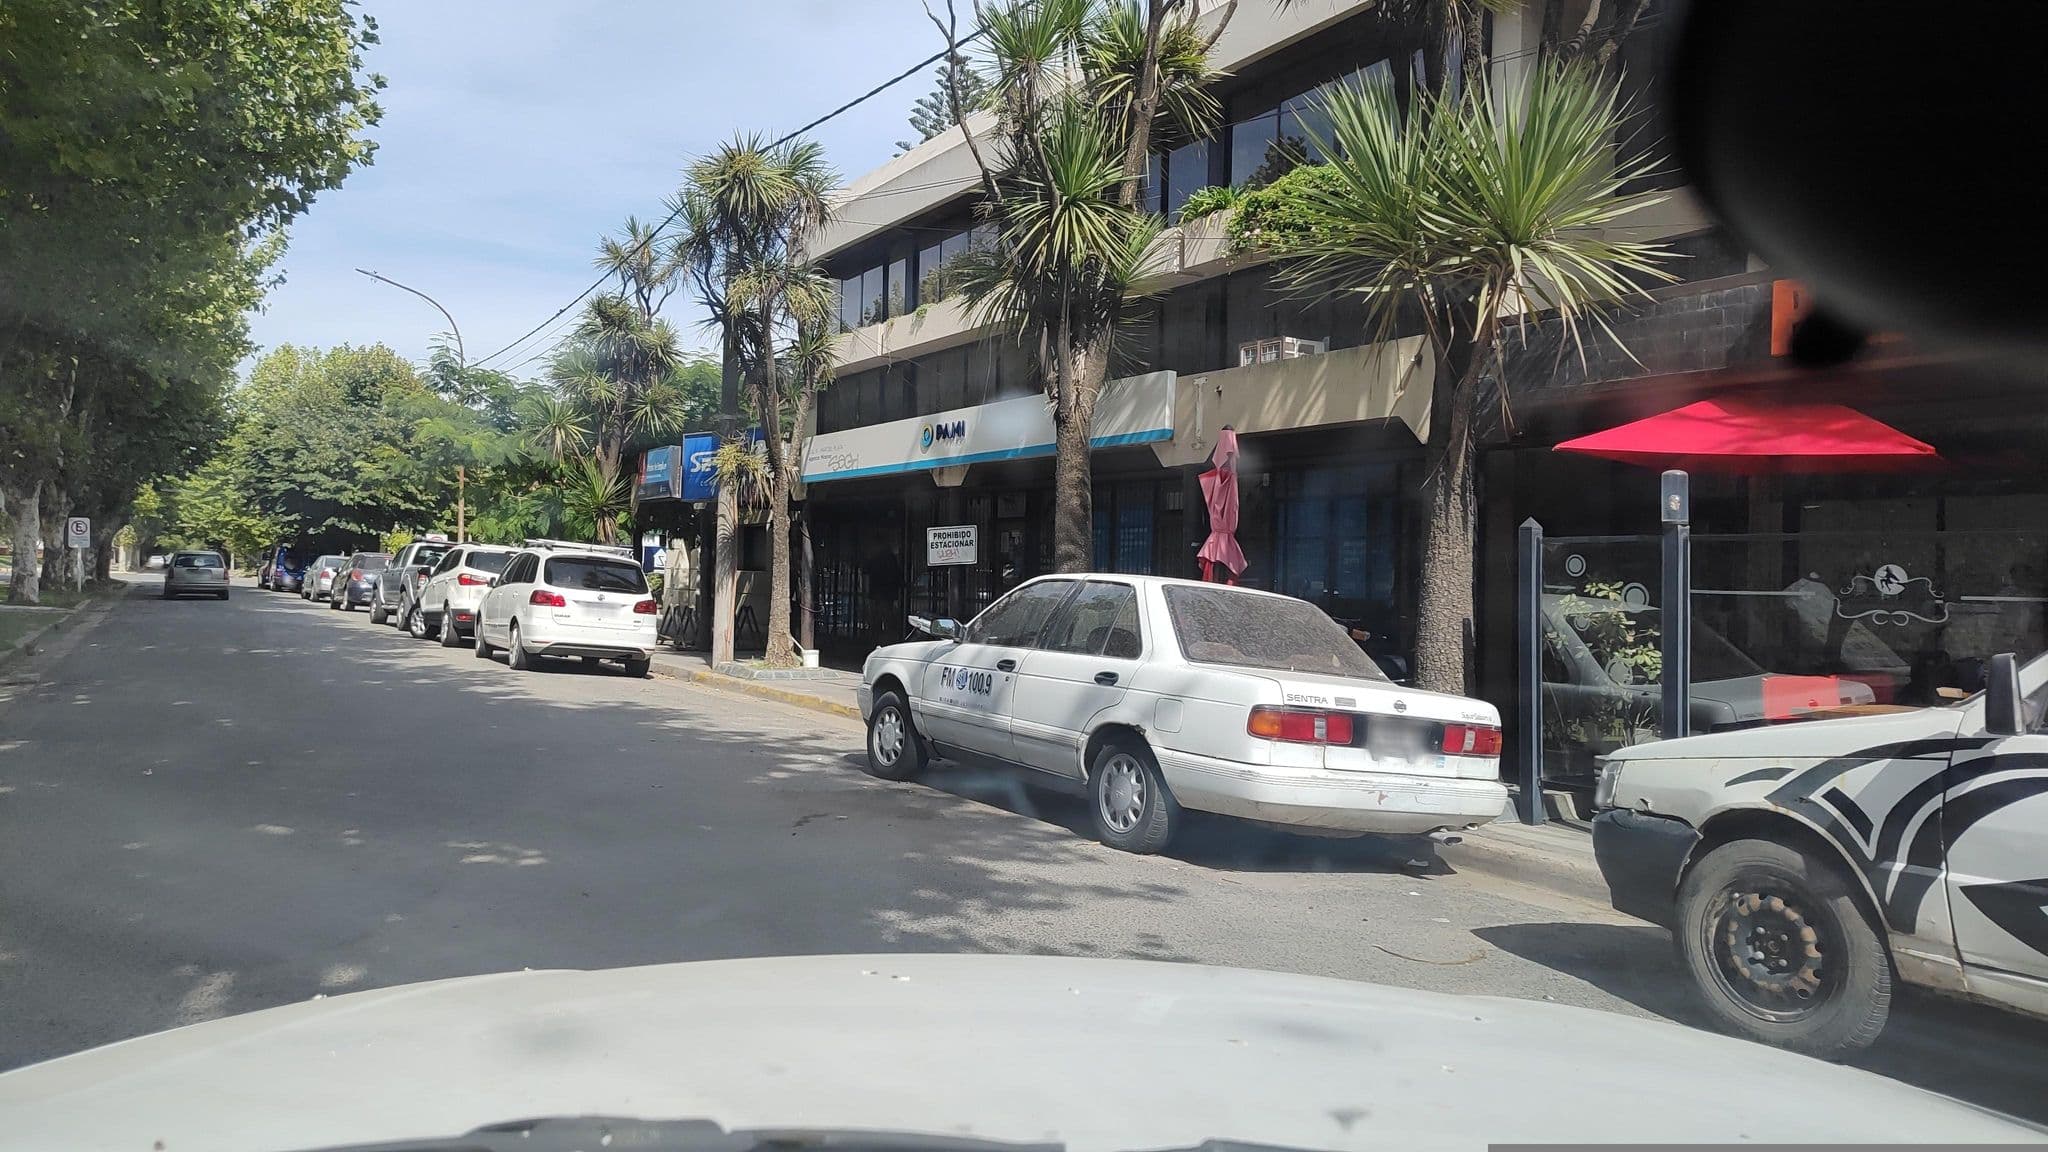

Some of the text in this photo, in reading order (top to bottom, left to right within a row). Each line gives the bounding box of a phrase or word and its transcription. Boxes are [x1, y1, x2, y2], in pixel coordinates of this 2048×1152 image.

[933, 530, 972, 540] PROHIBIDO
[930, 539, 974, 550] ESTACIONAR
[941, 666, 993, 696] FM 100.9
[1286, 693, 1329, 704] SENTRA
